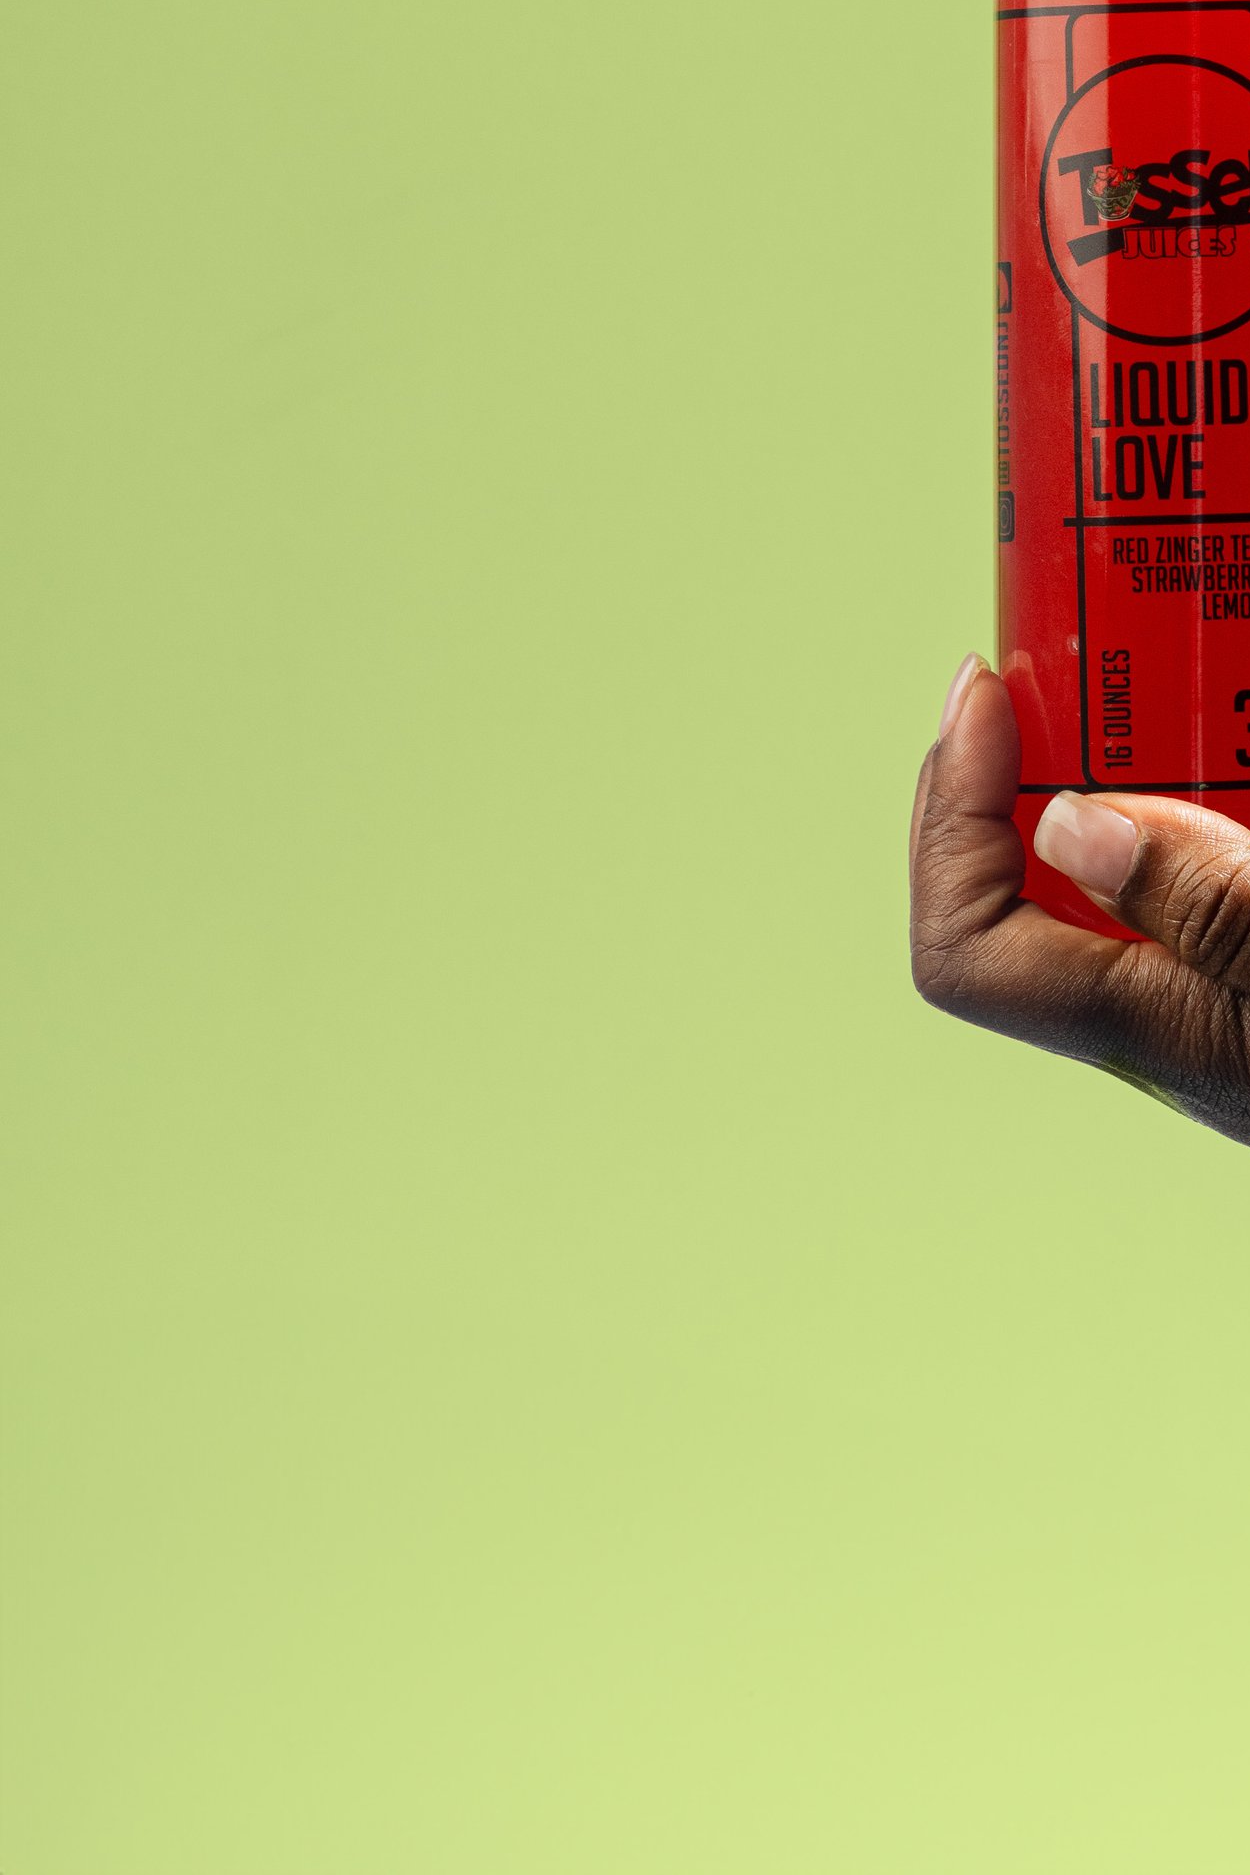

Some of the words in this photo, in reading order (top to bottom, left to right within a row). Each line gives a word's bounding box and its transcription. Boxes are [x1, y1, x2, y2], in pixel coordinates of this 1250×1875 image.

[1122, 226, 1237, 259] JUICES
[1089, 359, 1249, 429] LIQUID
[1092, 433, 1207, 502] LOVE
[1113, 537, 1149, 565] RED
[1155, 535, 1223, 564] ZINGER
[1102, 649, 1132, 738] OUNCES
[1104, 743, 1133, 770] 16
